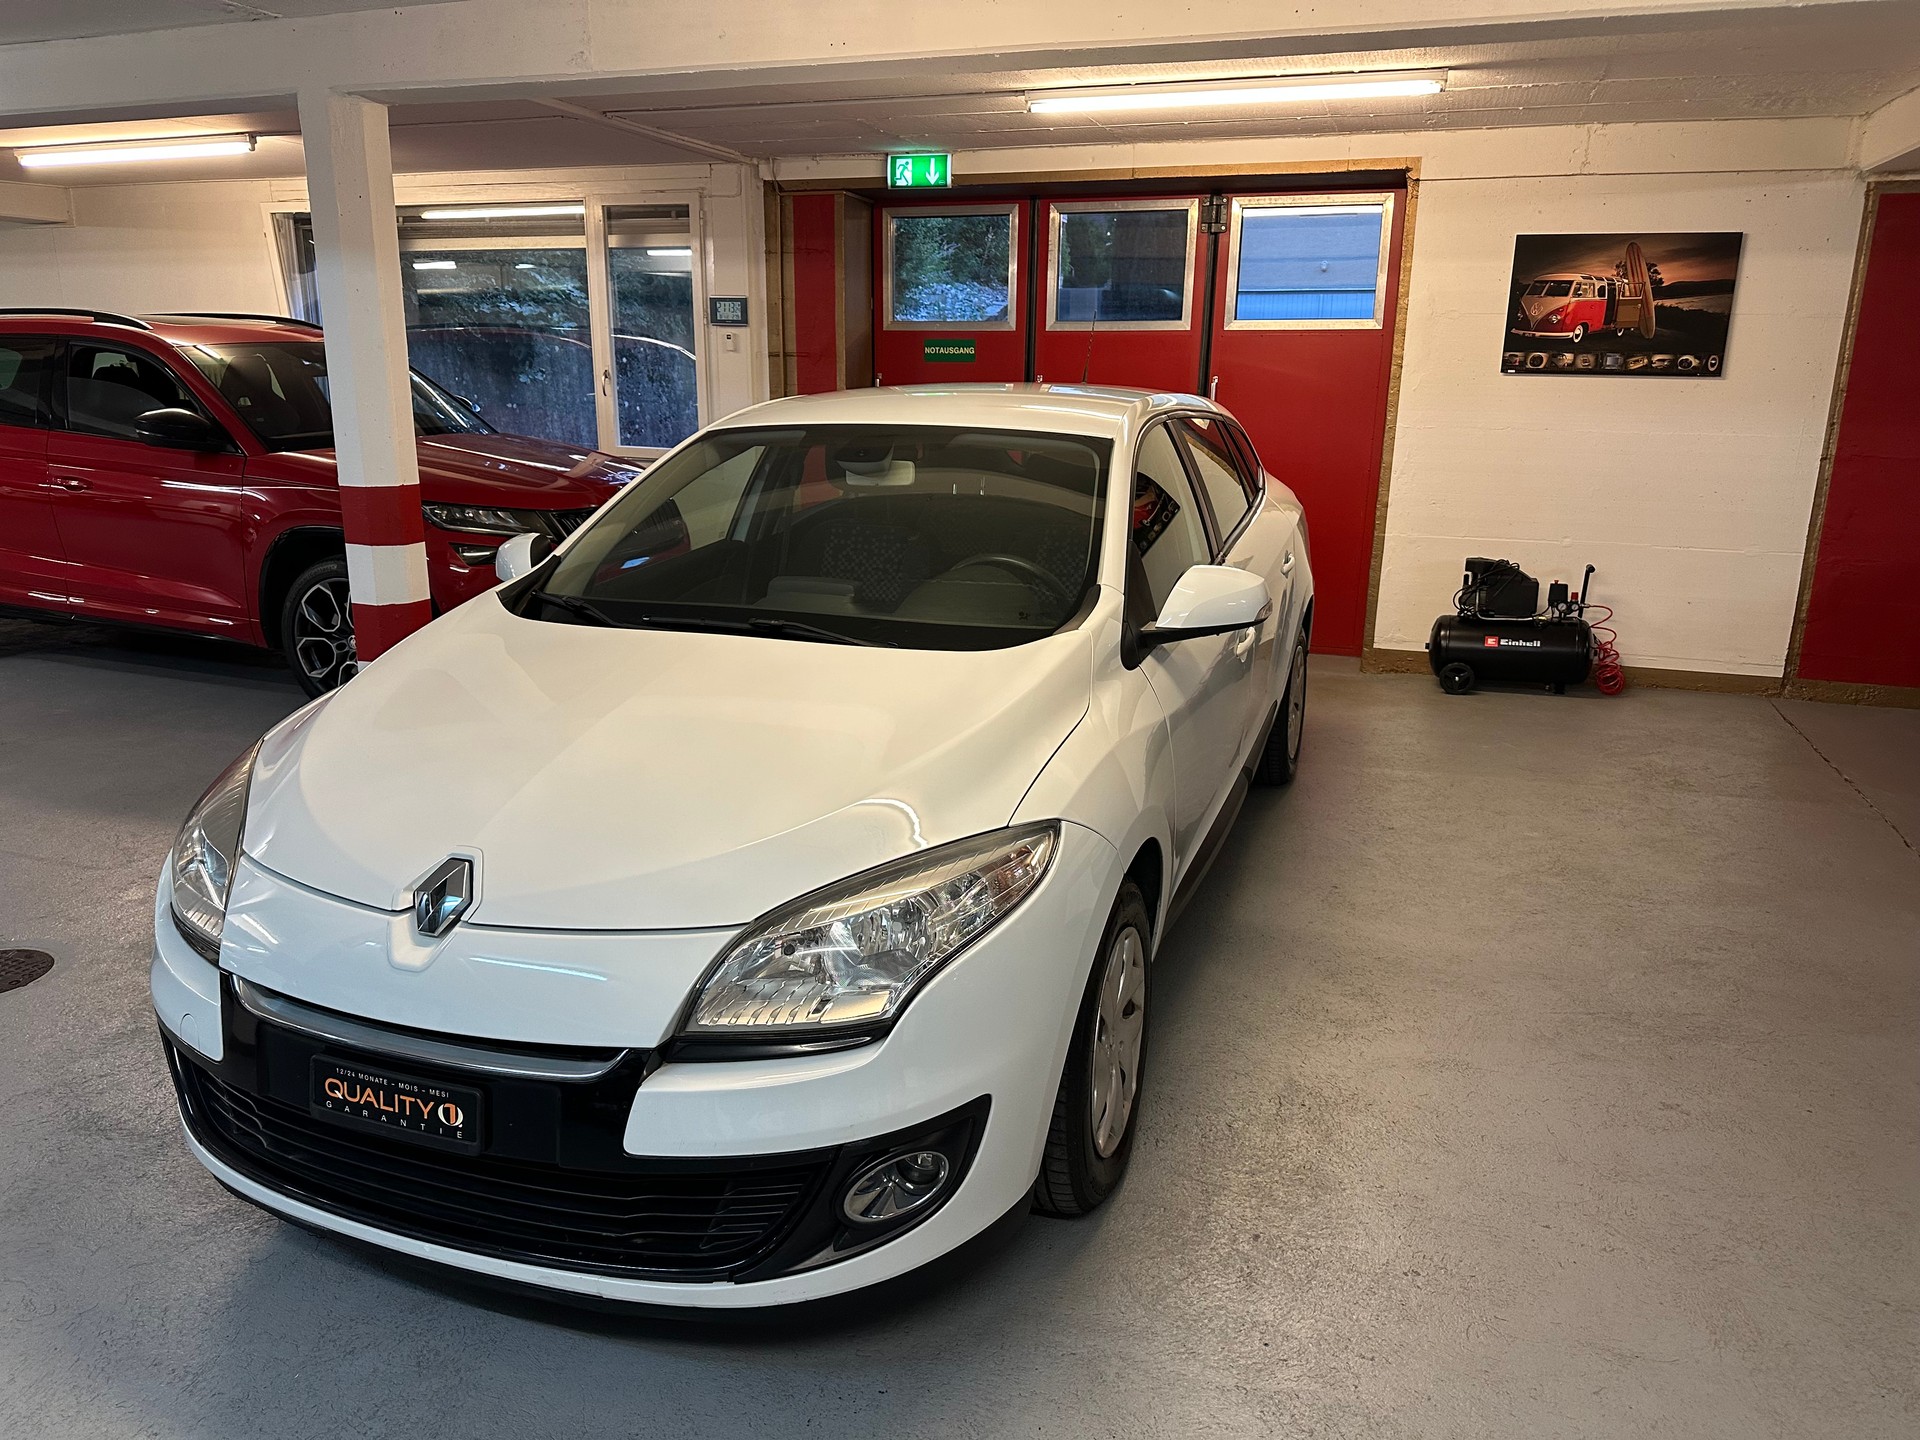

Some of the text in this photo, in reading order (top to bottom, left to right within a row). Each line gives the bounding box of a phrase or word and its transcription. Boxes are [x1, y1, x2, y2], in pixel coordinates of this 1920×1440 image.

[924, 346, 975, 354] NOTAUSGANG
[1500, 638, 1541, 647] Einhell
[324, 1077, 435, 1119] QUALITY
[336, 1067, 356, 1078] 12/24
[358, 1073, 388, 1086] MONATE
[398, 1083, 419, 1092] MOIS
[429, 1088, 450, 1098] MESI
[325, 1100, 463, 1139] GARANTIE
